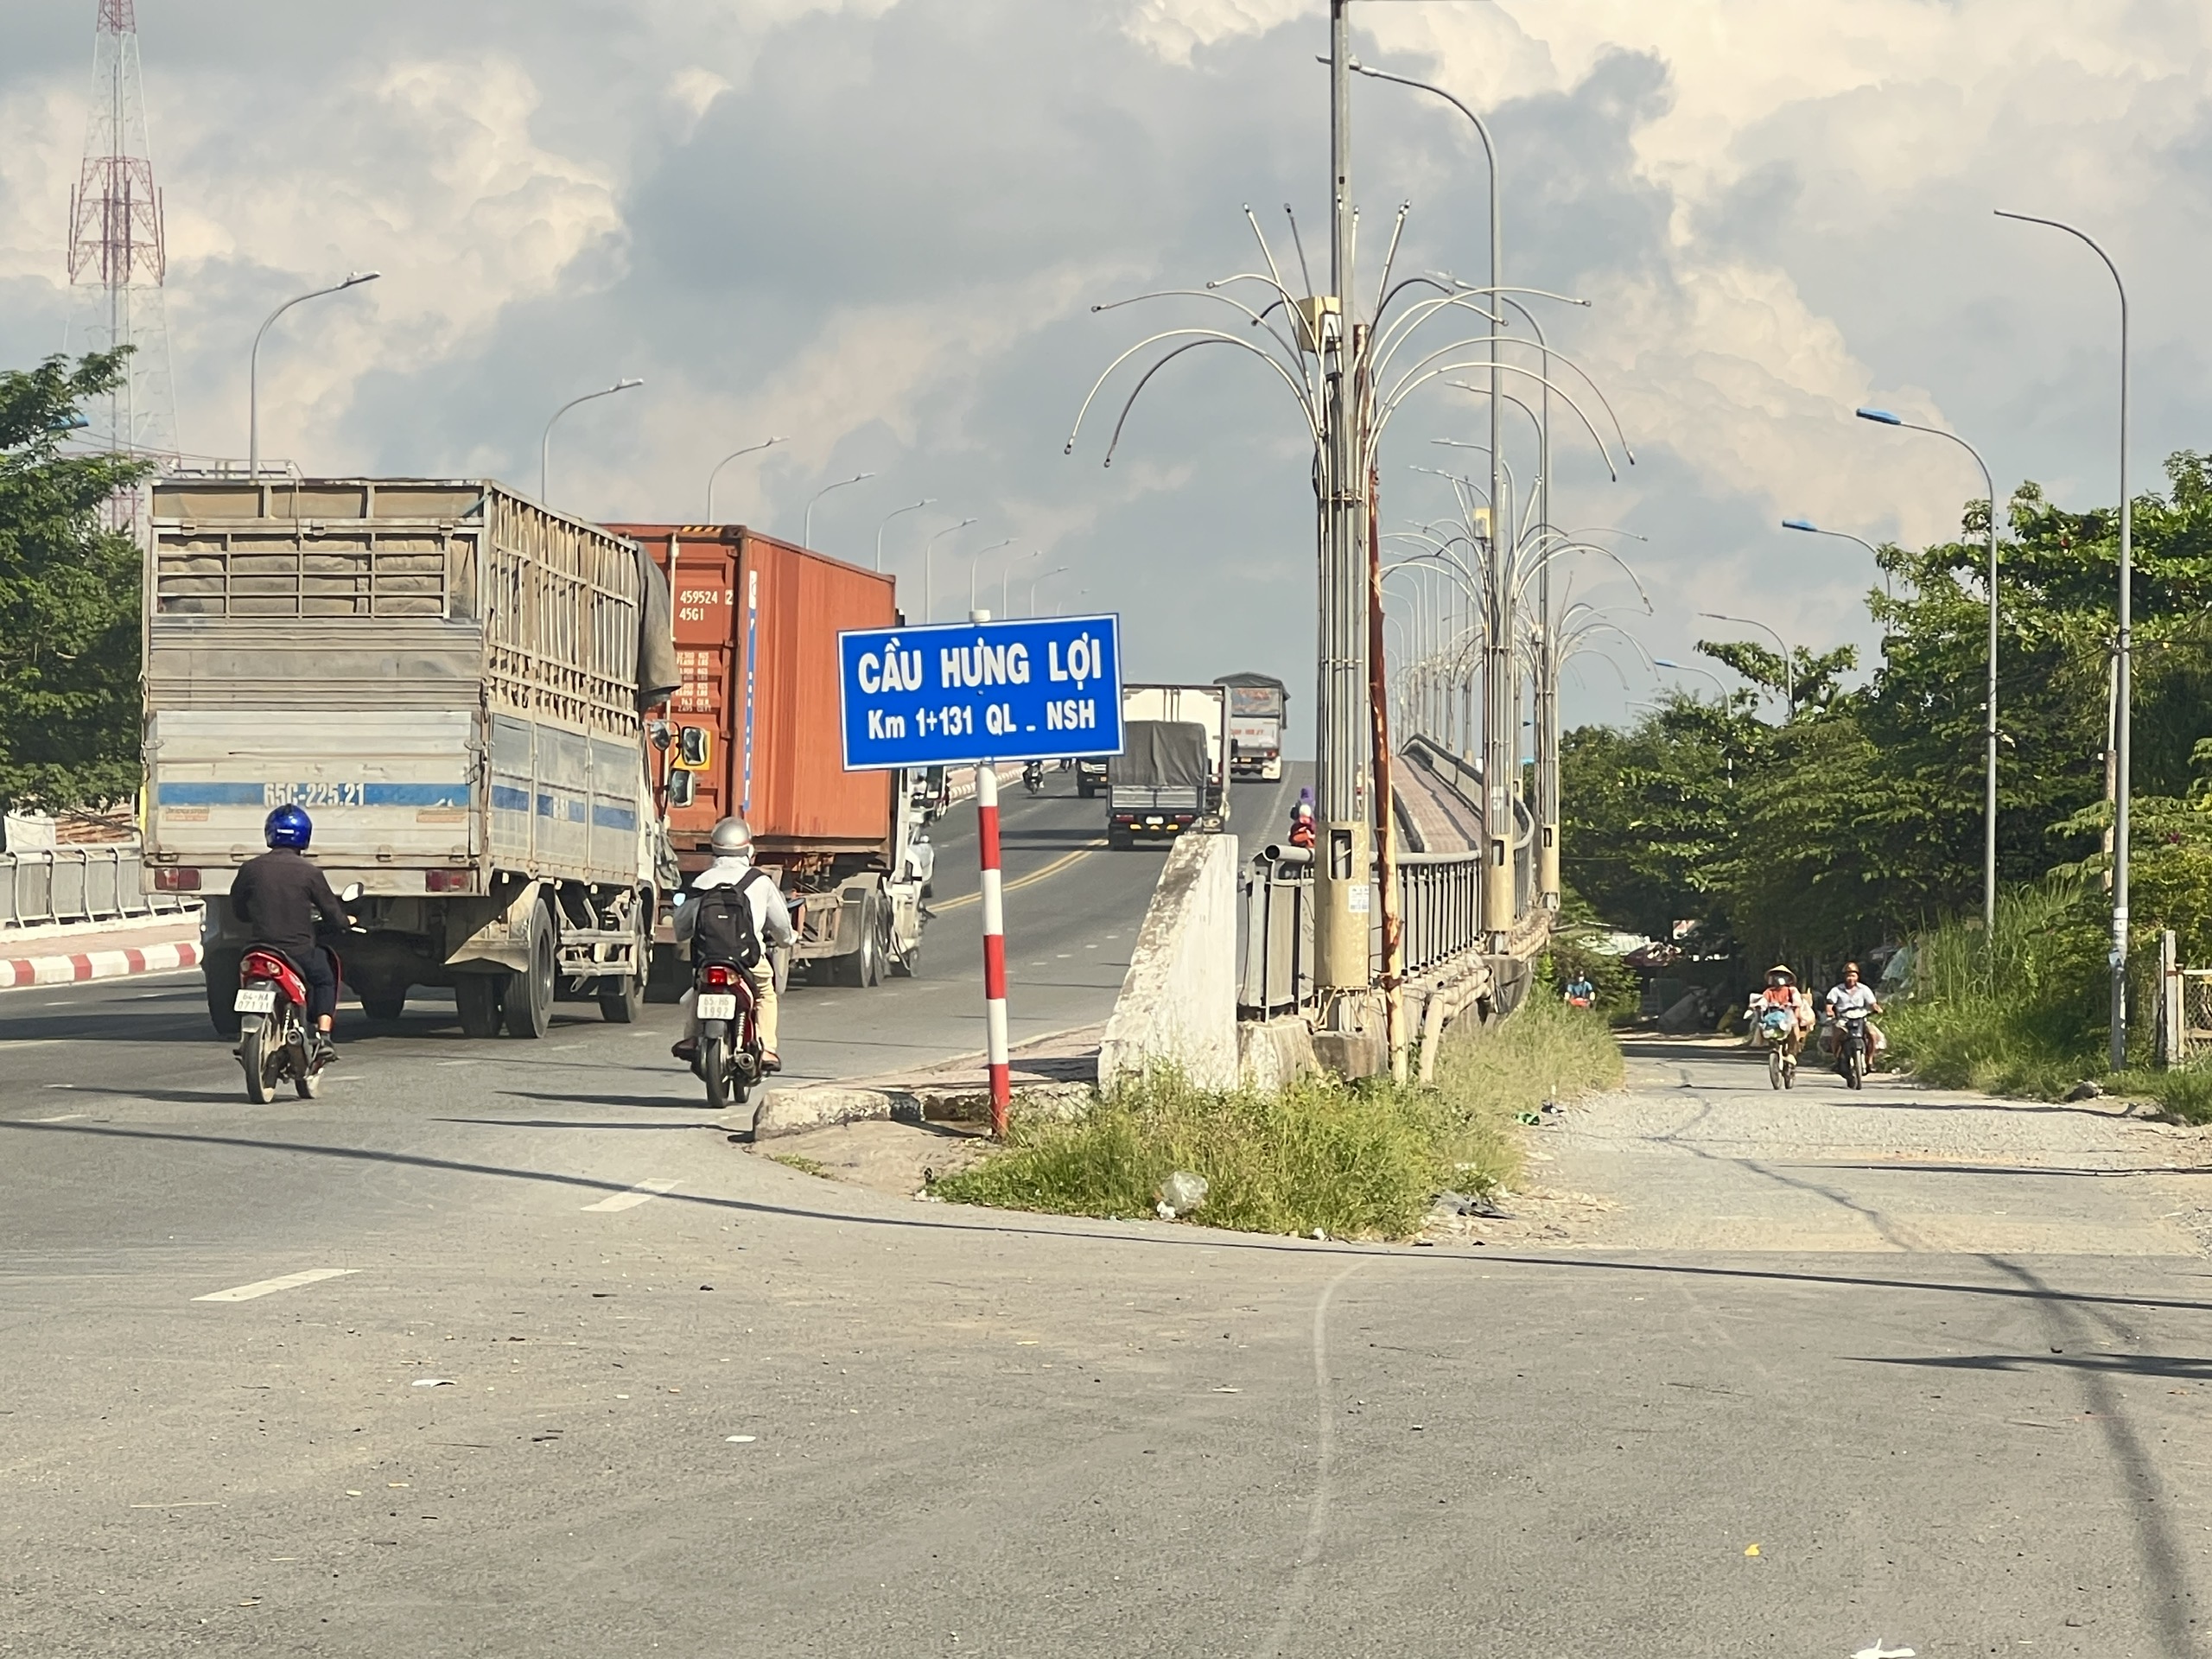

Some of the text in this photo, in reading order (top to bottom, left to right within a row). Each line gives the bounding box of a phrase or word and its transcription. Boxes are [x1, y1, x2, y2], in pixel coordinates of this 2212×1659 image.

[679, 590, 734, 605] 459524 2
[679, 607, 704, 621] 45G1
[858, 632, 1102, 694] CẦU HƯNG LỢI
[868, 709, 906, 740] Km
[915, 705, 973, 737] 1+131
[986, 703, 1017, 736] QL
[1046, 699, 1096, 730] NSH
[264, 783, 364, 807] 65C-225.21
